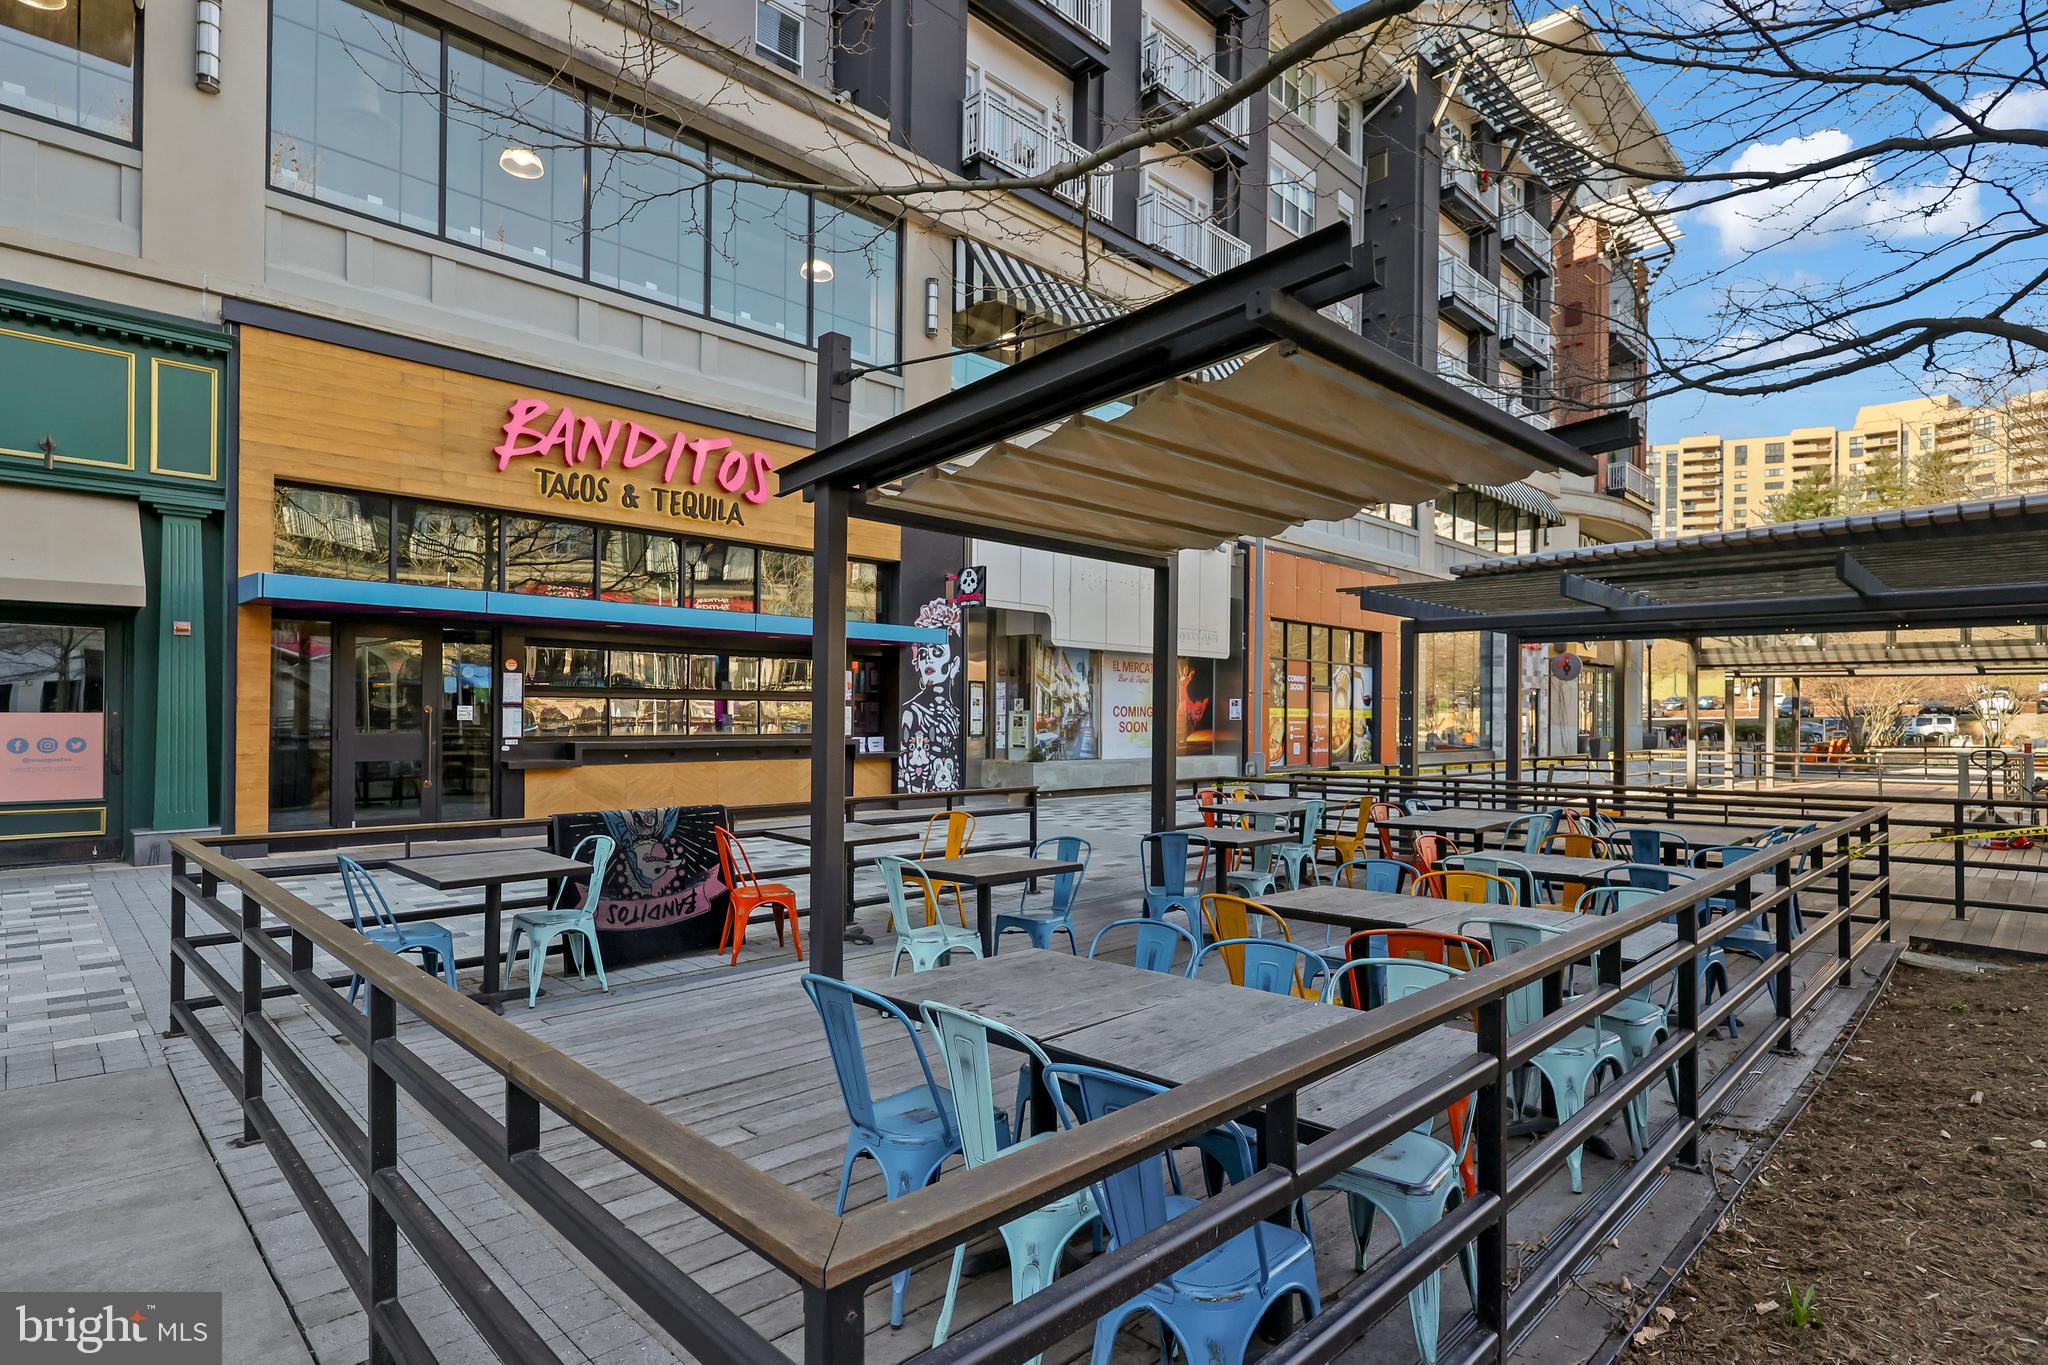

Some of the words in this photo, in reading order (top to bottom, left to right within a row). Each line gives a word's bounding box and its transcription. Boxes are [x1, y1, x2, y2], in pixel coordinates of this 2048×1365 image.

[492, 399, 776, 505] BANDITOS
[534, 467, 610, 504] TACOS
[621, 484, 640, 509] &
[650, 486, 745, 526] TEQUILA
[1112, 660, 1121, 672] EL
[1112, 705, 1153, 718] COMING
[1118, 721, 1148, 733] SOON
[606, 889, 698, 927] BANDITOS
